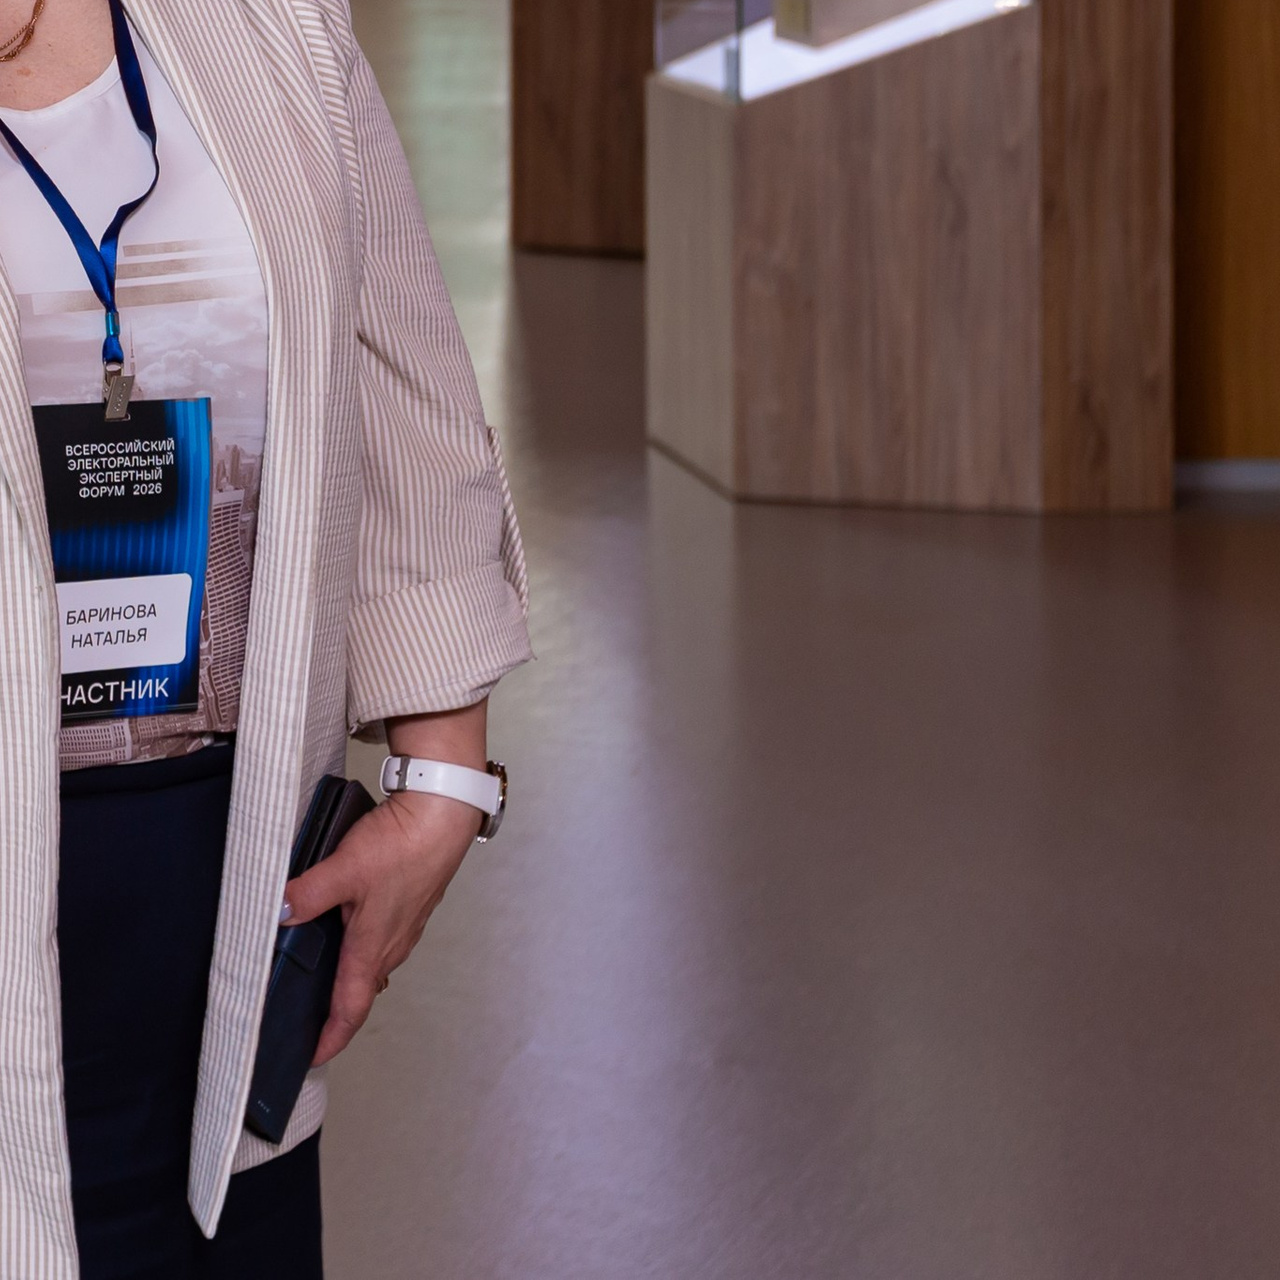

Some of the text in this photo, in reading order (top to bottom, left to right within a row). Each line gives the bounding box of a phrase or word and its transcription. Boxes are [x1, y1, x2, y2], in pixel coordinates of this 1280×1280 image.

[65, 437, 175, 456] ВСЕРОССИЙСКИЙ
[67, 452, 174, 471] ЭЛЕКТОРАЛЬНЫЙ
[79, 467, 163, 484] ЭКСПЕРТНЫЙ
[79, 483, 162, 498] ФОРУМ 2026
[66, 603, 157, 625] БАРИНОВА
[71, 627, 148, 648] НАТАЛЬЯ
[60, 677, 169, 706] ЧАСТНИК
